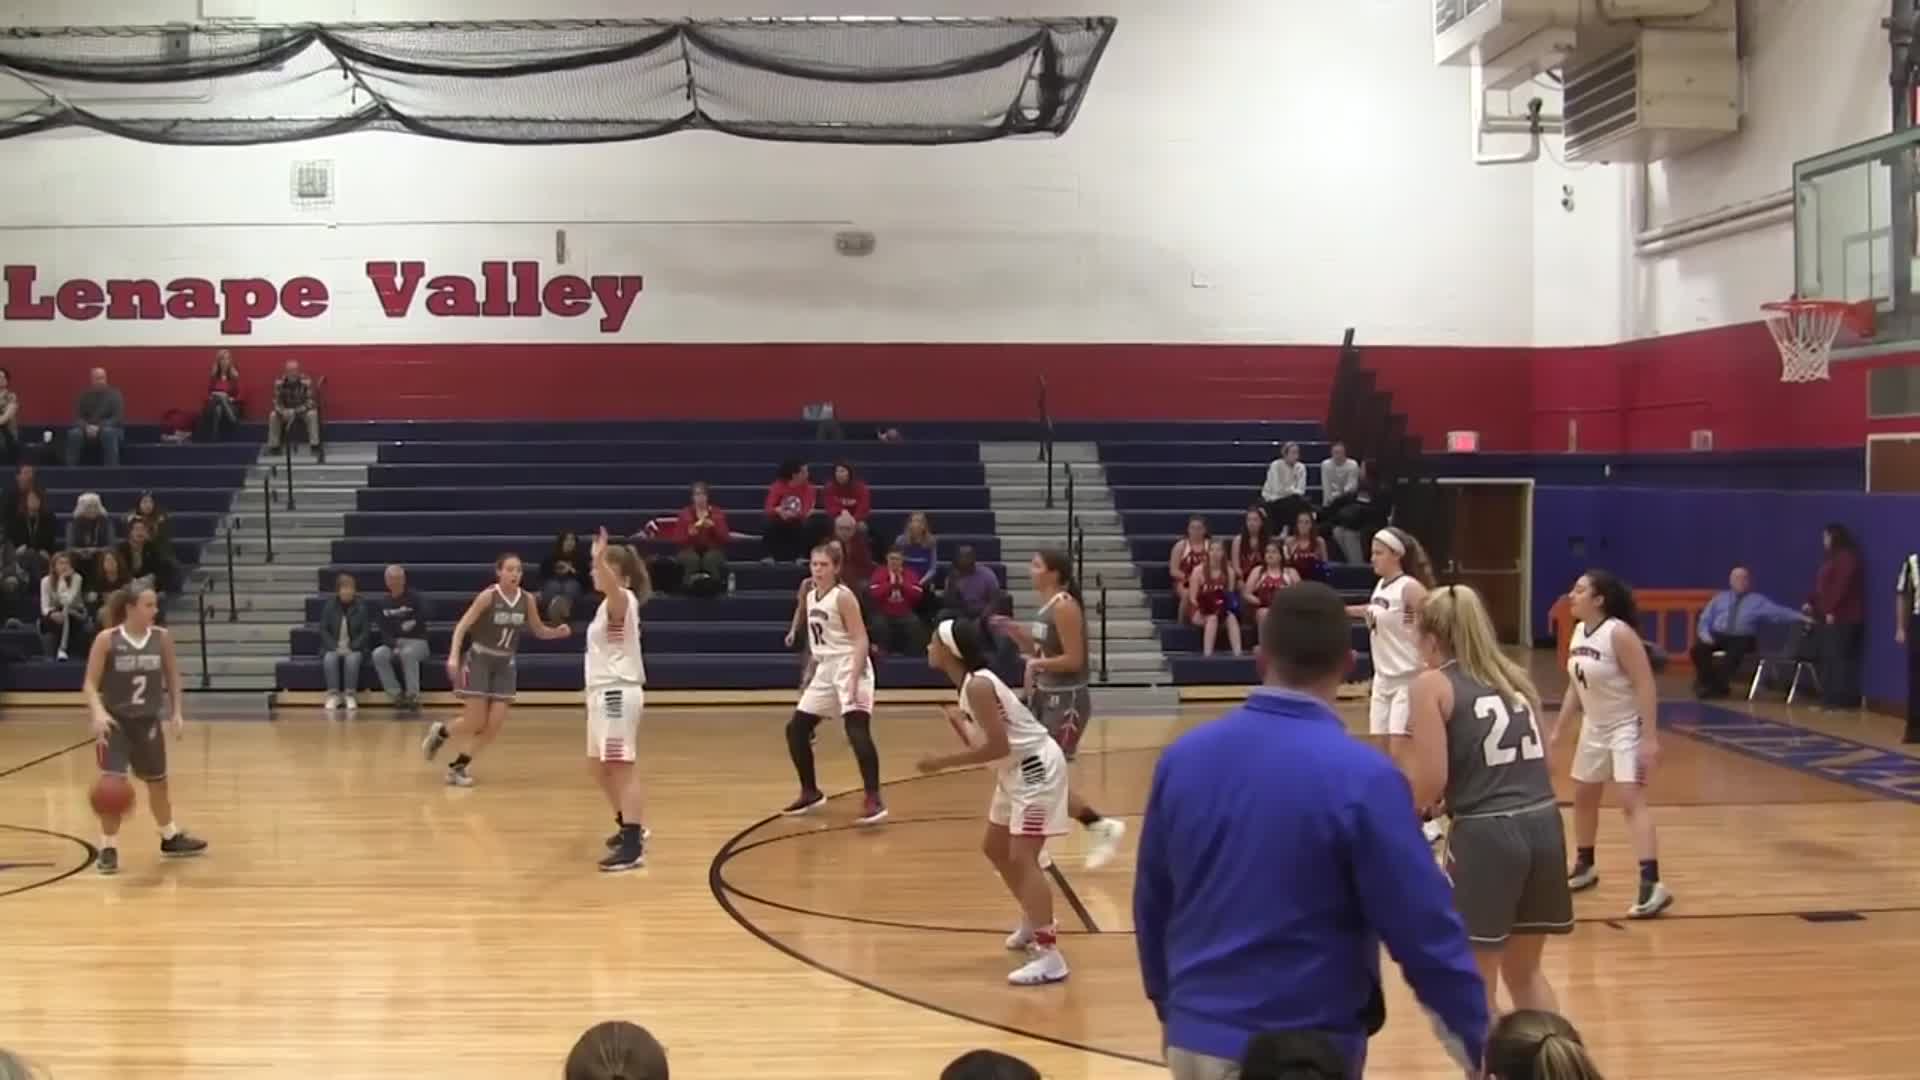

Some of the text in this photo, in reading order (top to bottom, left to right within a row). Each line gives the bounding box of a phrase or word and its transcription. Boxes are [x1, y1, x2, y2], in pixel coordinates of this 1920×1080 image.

[4, 261, 643, 334] Lenape Valley
[131, 674, 148, 705] 2
[1574, 662, 1588, 689] 4
[1473, 693, 1545, 767] 23
